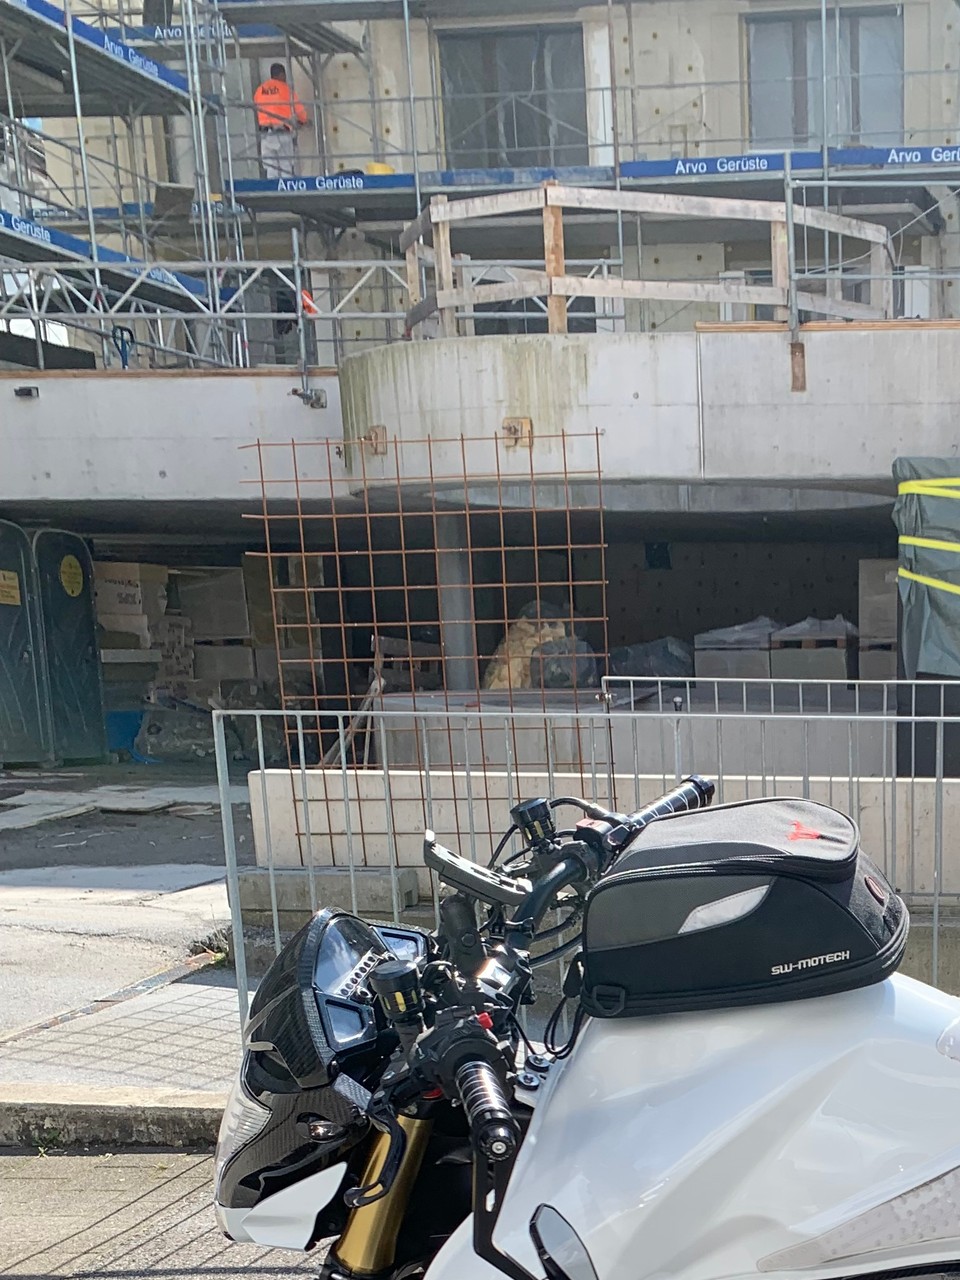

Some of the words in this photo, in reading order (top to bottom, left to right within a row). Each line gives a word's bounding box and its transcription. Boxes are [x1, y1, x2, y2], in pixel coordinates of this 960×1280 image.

[154, 25, 182, 39] Arvo
[887, 148, 922, 164] Arvo
[675, 160, 707, 175] Arvo
[716, 157, 769, 172] Gerüste
[277, 178, 307, 191] Arvo
[315, 175, 364, 189] Gerüste
[770, 949, 851, 976] SW-MOTECH
